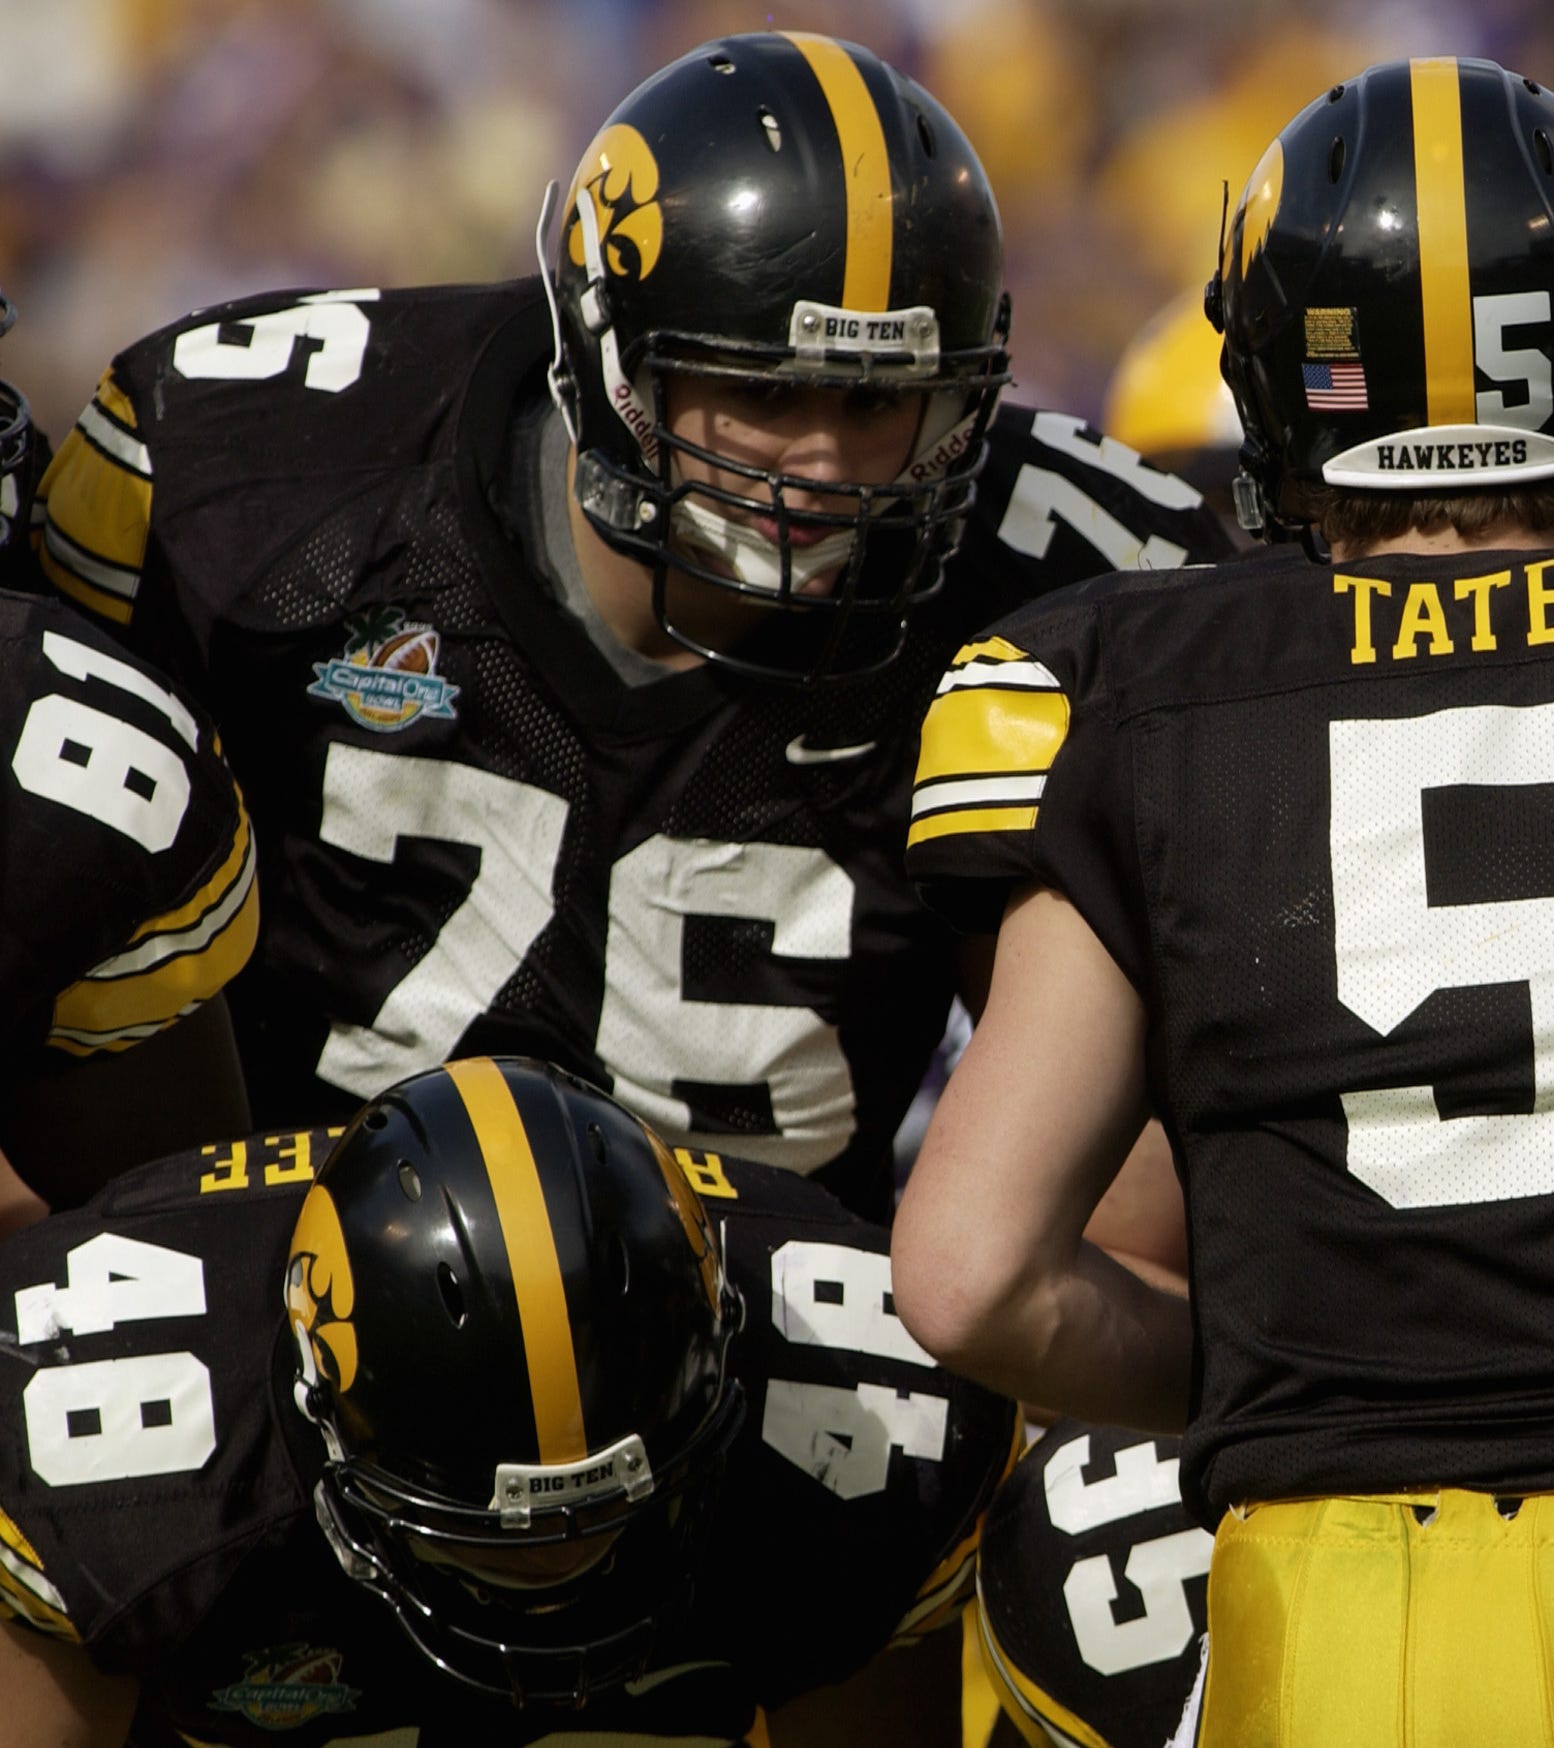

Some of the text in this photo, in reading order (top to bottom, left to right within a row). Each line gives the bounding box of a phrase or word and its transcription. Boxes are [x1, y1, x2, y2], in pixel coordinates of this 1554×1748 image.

[825, 318, 905, 341] BIG TEN
[1473, 290, 1553, 430] 5
[614, 384, 661, 460] Riddell
[1377, 439, 1528, 471] HAWKEYES
[315, 742, 858, 1177] 76
[14, 1232, 216, 1487] 48
[762, 1240, 950, 1500] 48
[529, 1465, 614, 1494] BIG TEN
